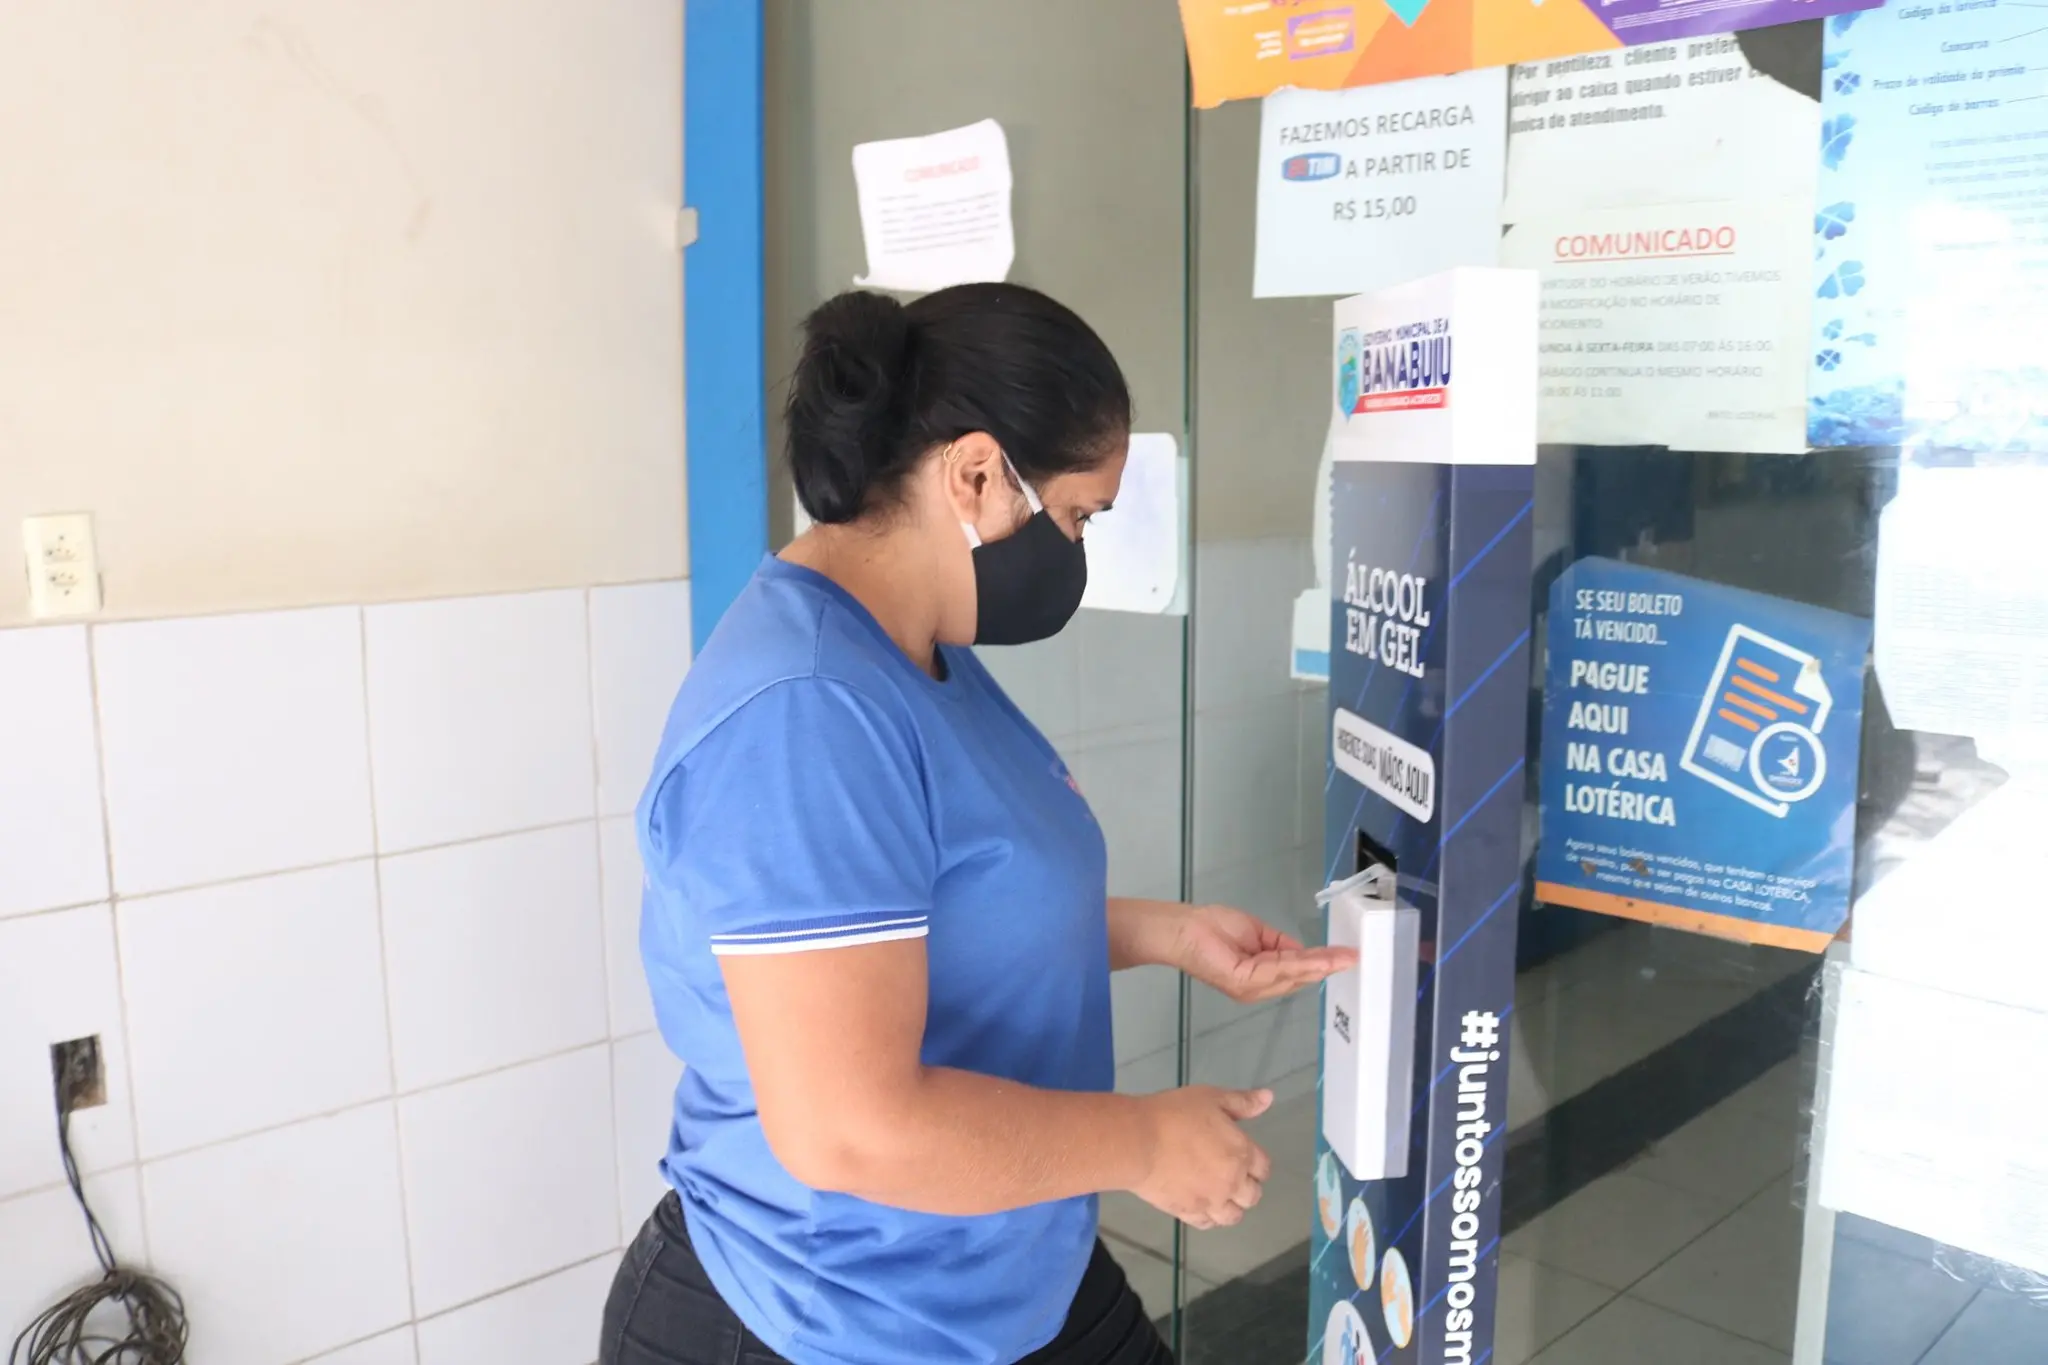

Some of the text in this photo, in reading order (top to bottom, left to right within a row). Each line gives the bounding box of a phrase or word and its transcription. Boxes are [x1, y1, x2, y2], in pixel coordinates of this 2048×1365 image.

[1516, 65, 1538, 80] Por
[1625, 45, 1677, 66] cliente
[1557, 87, 1572, 101] ao
[1580, 80, 1618, 98] caixa
[1625, 74, 1681, 95] quando
[1688, 66, 1742, 86] estiver
[1280, 105, 1475, 145] FAZEMOS RECARGA
[1550, 112, 1565, 128] de
[1345, 160, 1359, 179] A
[1365, 152, 1437, 177] PARTIR
[1443, 148, 1472, 170] DE
[1333, 195, 1417, 221] R$ 15,00
[1555, 226, 1736, 258] COMUNICADO
[1344, 547, 1430, 628] ÁLCOOL
[1575, 588, 1683, 616] SE SEU BOLETO
[1345, 608, 1425, 679] EM GEL
[1574, 612, 1593, 640] TÁ
[1570, 659, 1650, 694] PAGUE
[1568, 700, 1629, 735] AQUI
[1379, 745, 1404, 795] MÃOS
[1566, 741, 1667, 782] NA CASA
[1564, 781, 1676, 826] LOTÉRICA
[1565, 852, 1579, 863] de
[1722, 877, 1754, 893] CASA
[1704, 863, 1724, 874] que
[1596, 871, 1632, 885] mesmo
[1633, 878, 1652, 889] que
[1684, 886, 1699, 898] de
[1700, 890, 1734, 904] outros
